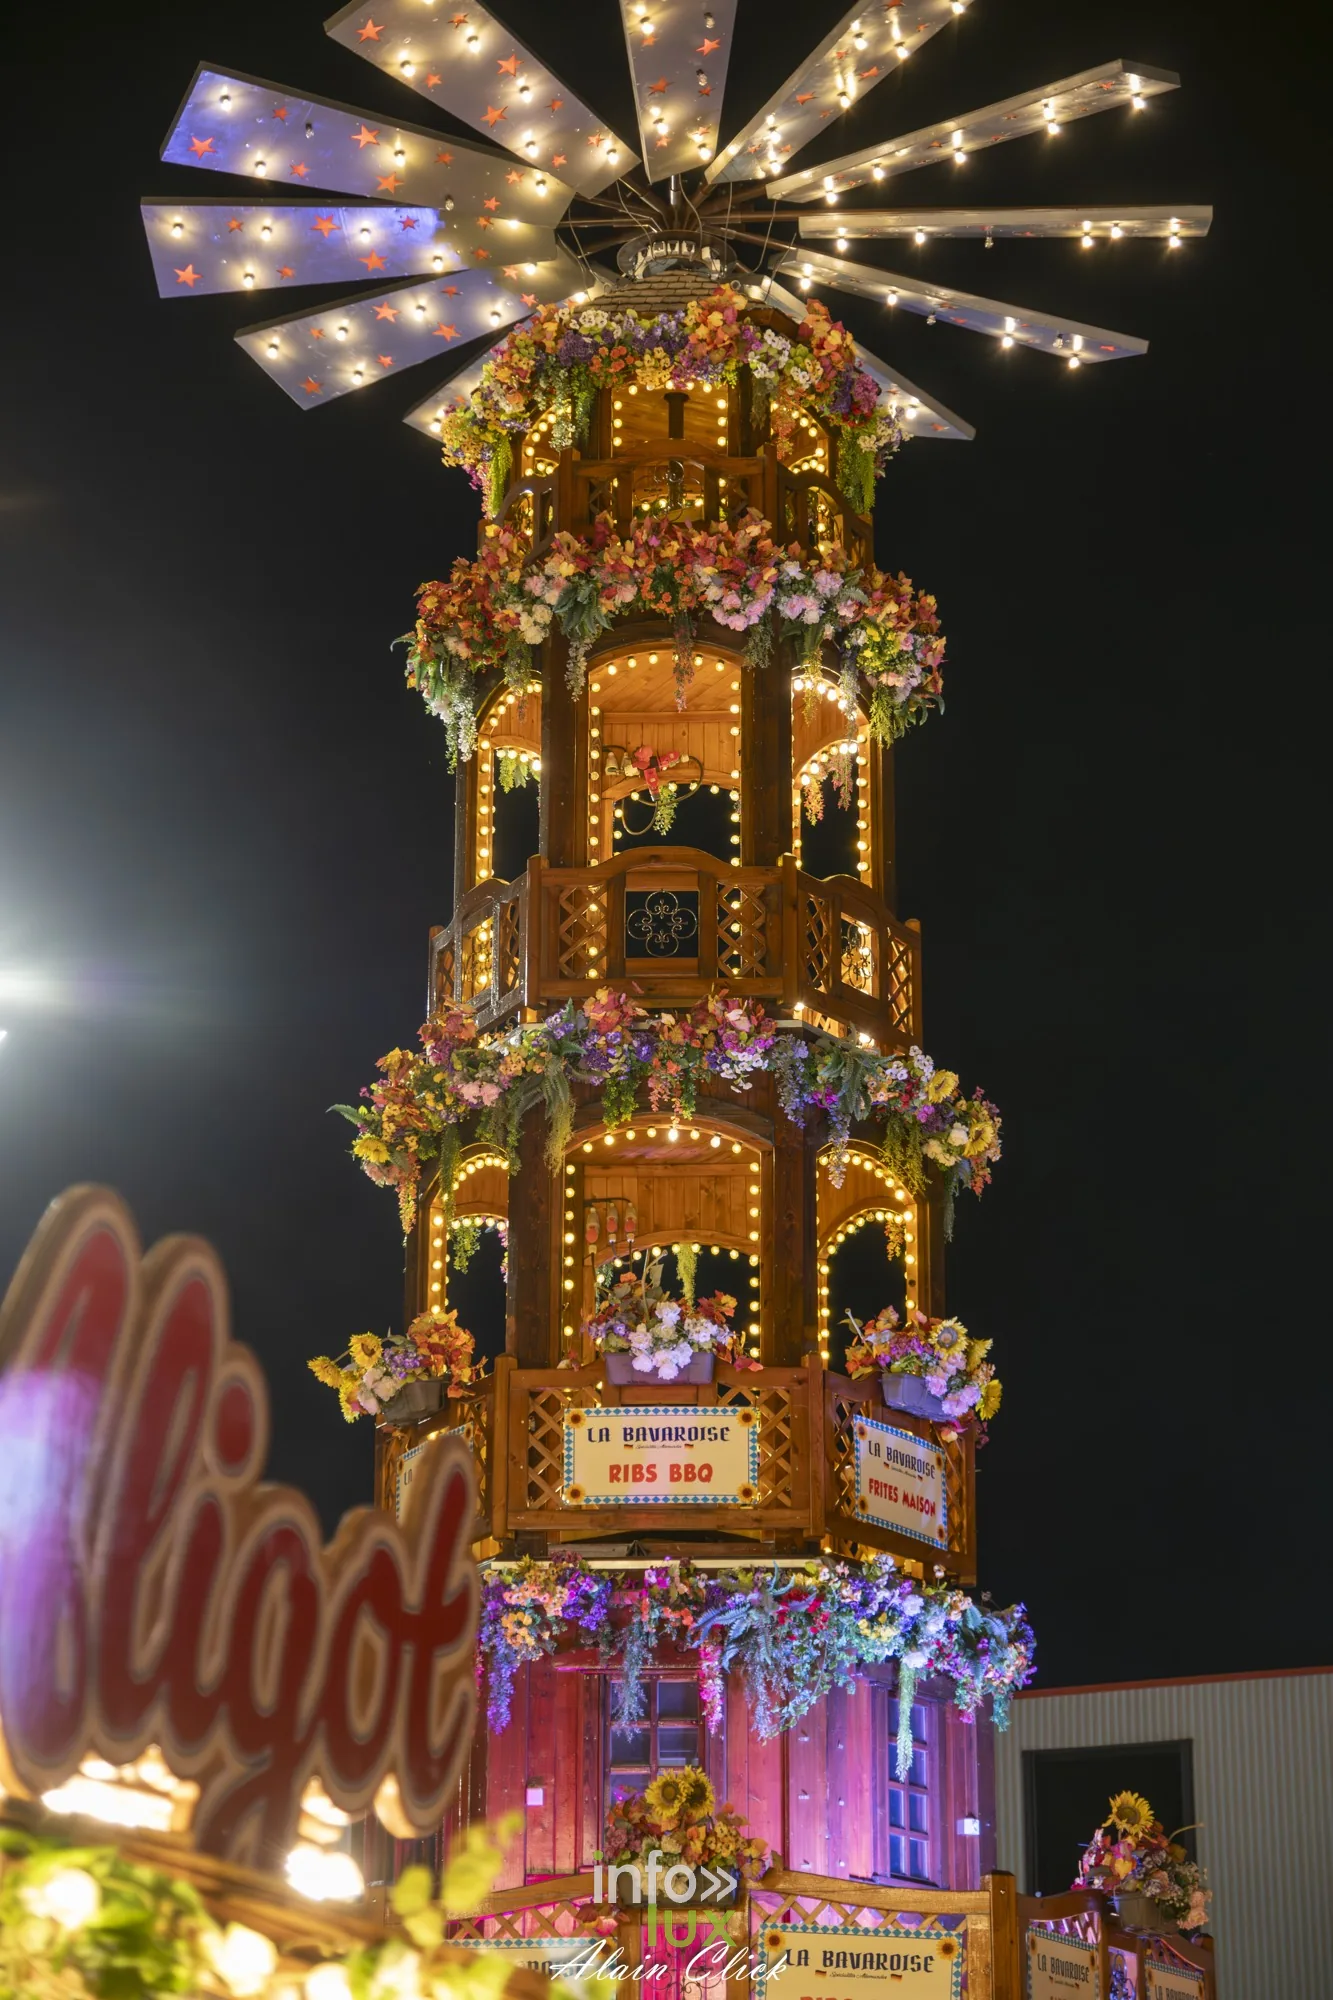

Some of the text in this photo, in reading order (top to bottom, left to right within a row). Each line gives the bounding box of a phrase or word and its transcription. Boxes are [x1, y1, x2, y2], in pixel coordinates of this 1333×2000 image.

[587, 1426, 731, 1443] LA BAVAROISE
[609, 1463, 714, 1483] RIBS BBQ
[868, 1440, 881, 1458] LA
[886, 1446, 936, 1480] BAVAROISE
[868, 1478, 936, 1517] FRITES MAISON
[786, 1949, 936, 1973] LA BAVAROISE
[1037, 1953, 1090, 1984] LA BAVAROISE
